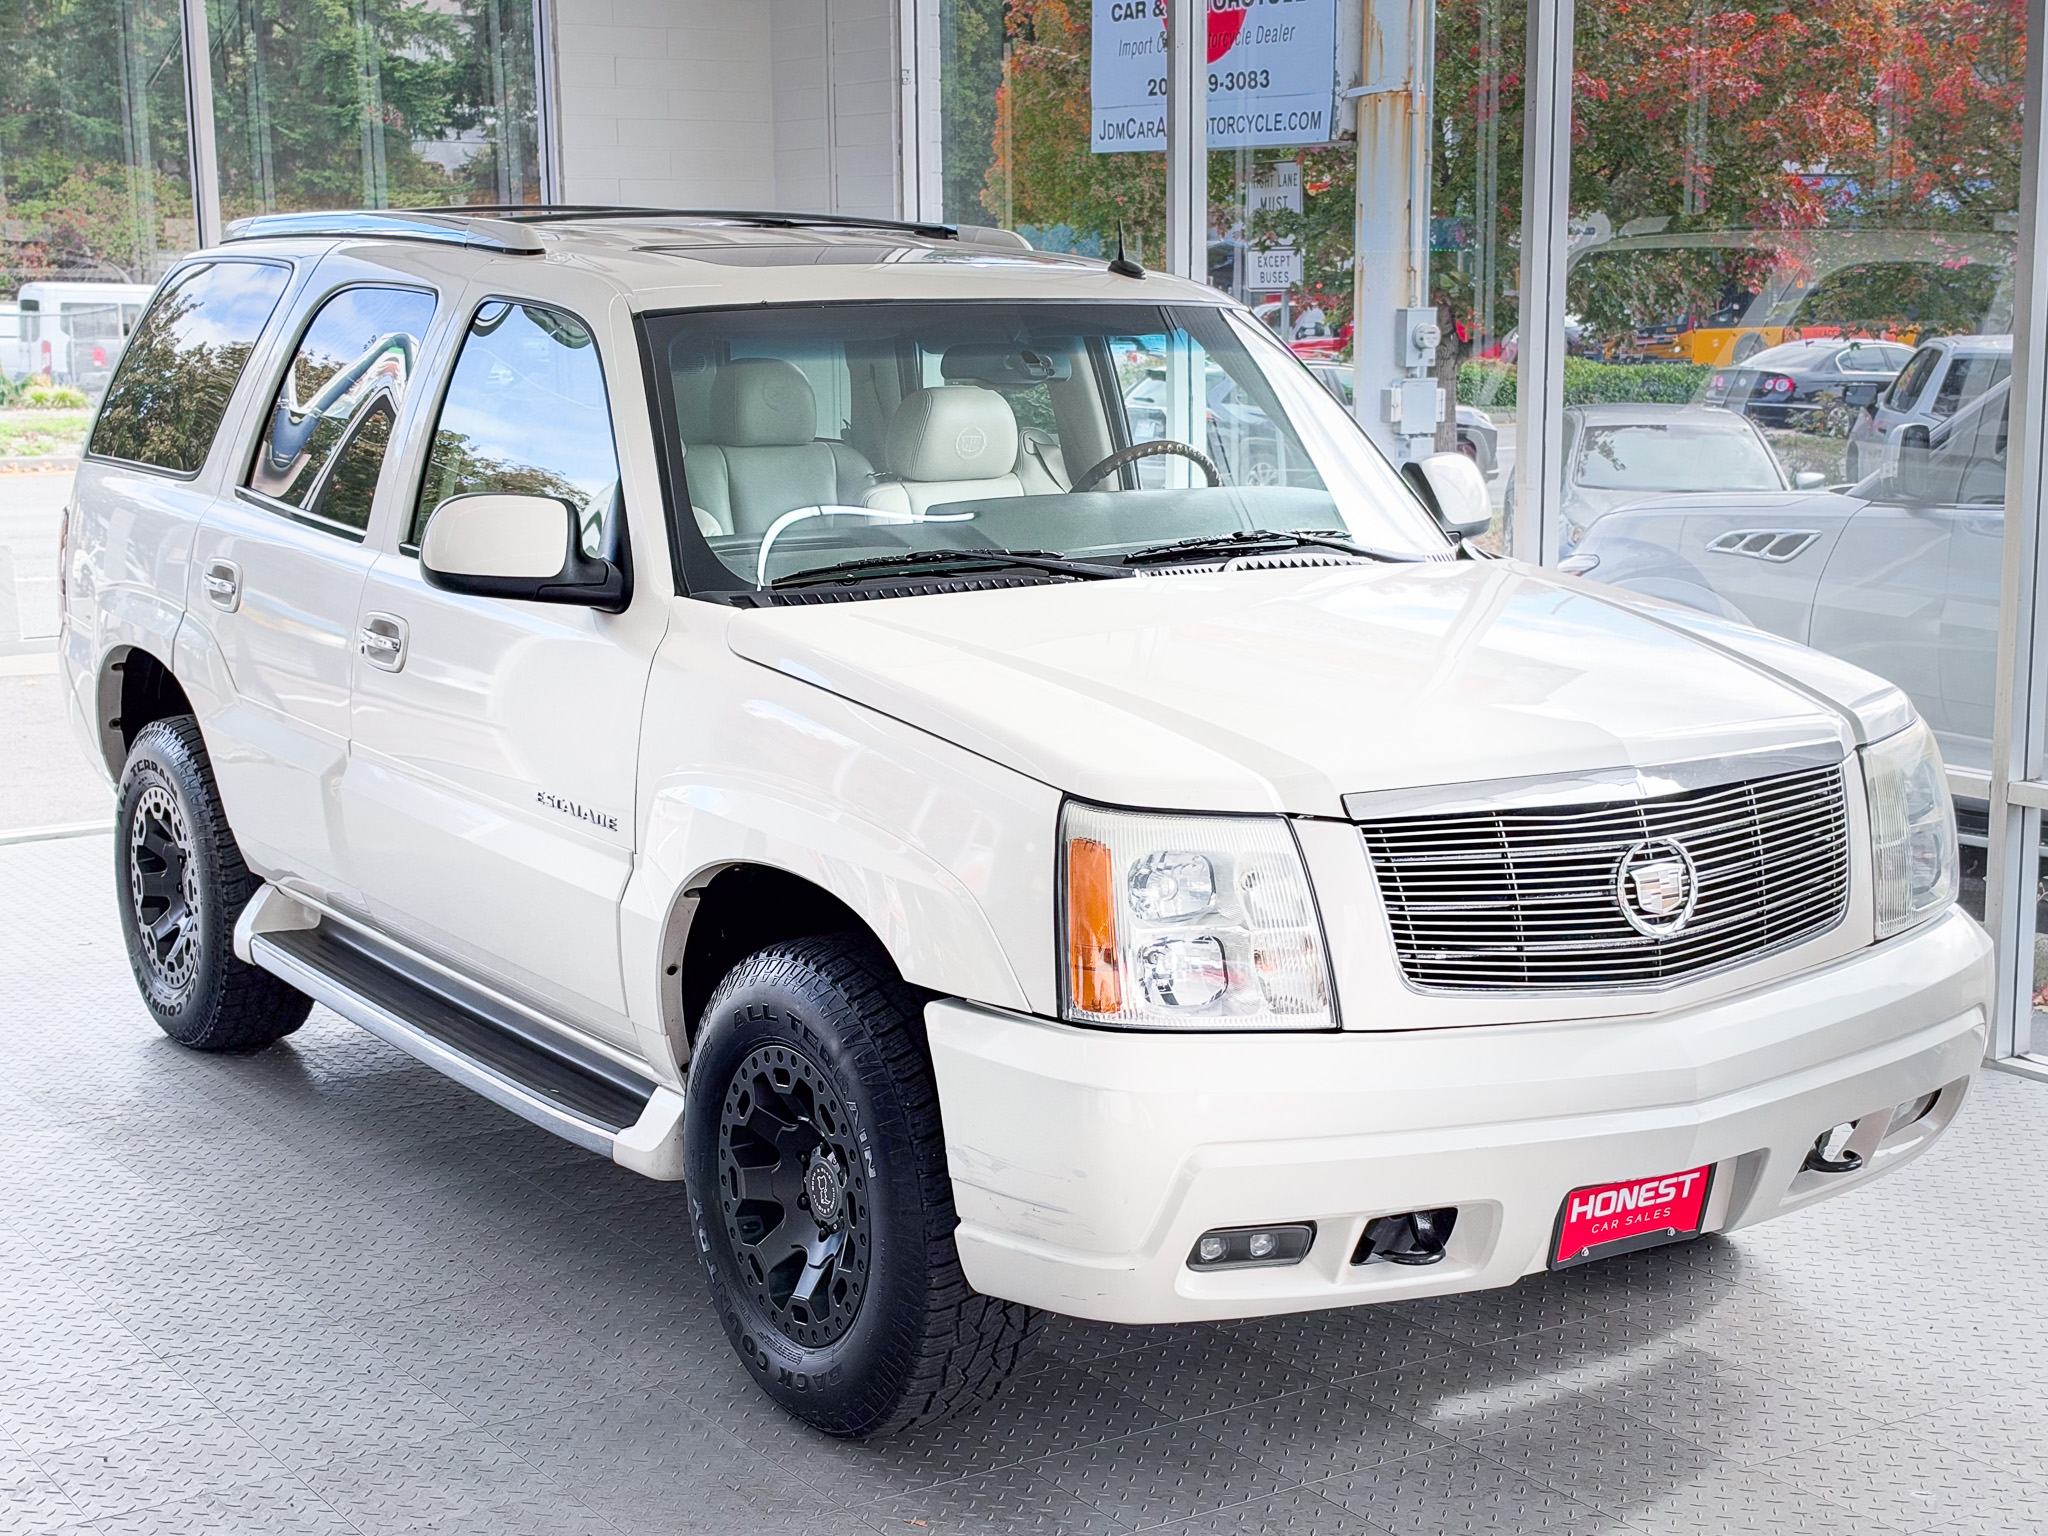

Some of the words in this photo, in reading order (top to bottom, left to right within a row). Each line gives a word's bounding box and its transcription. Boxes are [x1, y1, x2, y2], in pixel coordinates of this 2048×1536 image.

[1111, 1, 1147, 22] CAR
[1152, 0, 1166, 17] &
[1118, 37, 1153, 59] Import
[1208, 28, 1252, 50] torcycle
[1256, 24, 1296, 44] Dealer
[1277, 173, 1298, 187] LANE
[1260, 195, 1288, 212] MUST
[1257, 255, 1290, 267] EXCEPT
[1259, 271, 1289, 283] BUSES
[733, 1002, 779, 1030] ALL
[1570, 1172, 1701, 1223] HONEST
[1591, 1219, 1619, 1234] CAR
[1625, 1207, 1672, 1226] SALES
[777, 1363, 843, 1394] BACK
